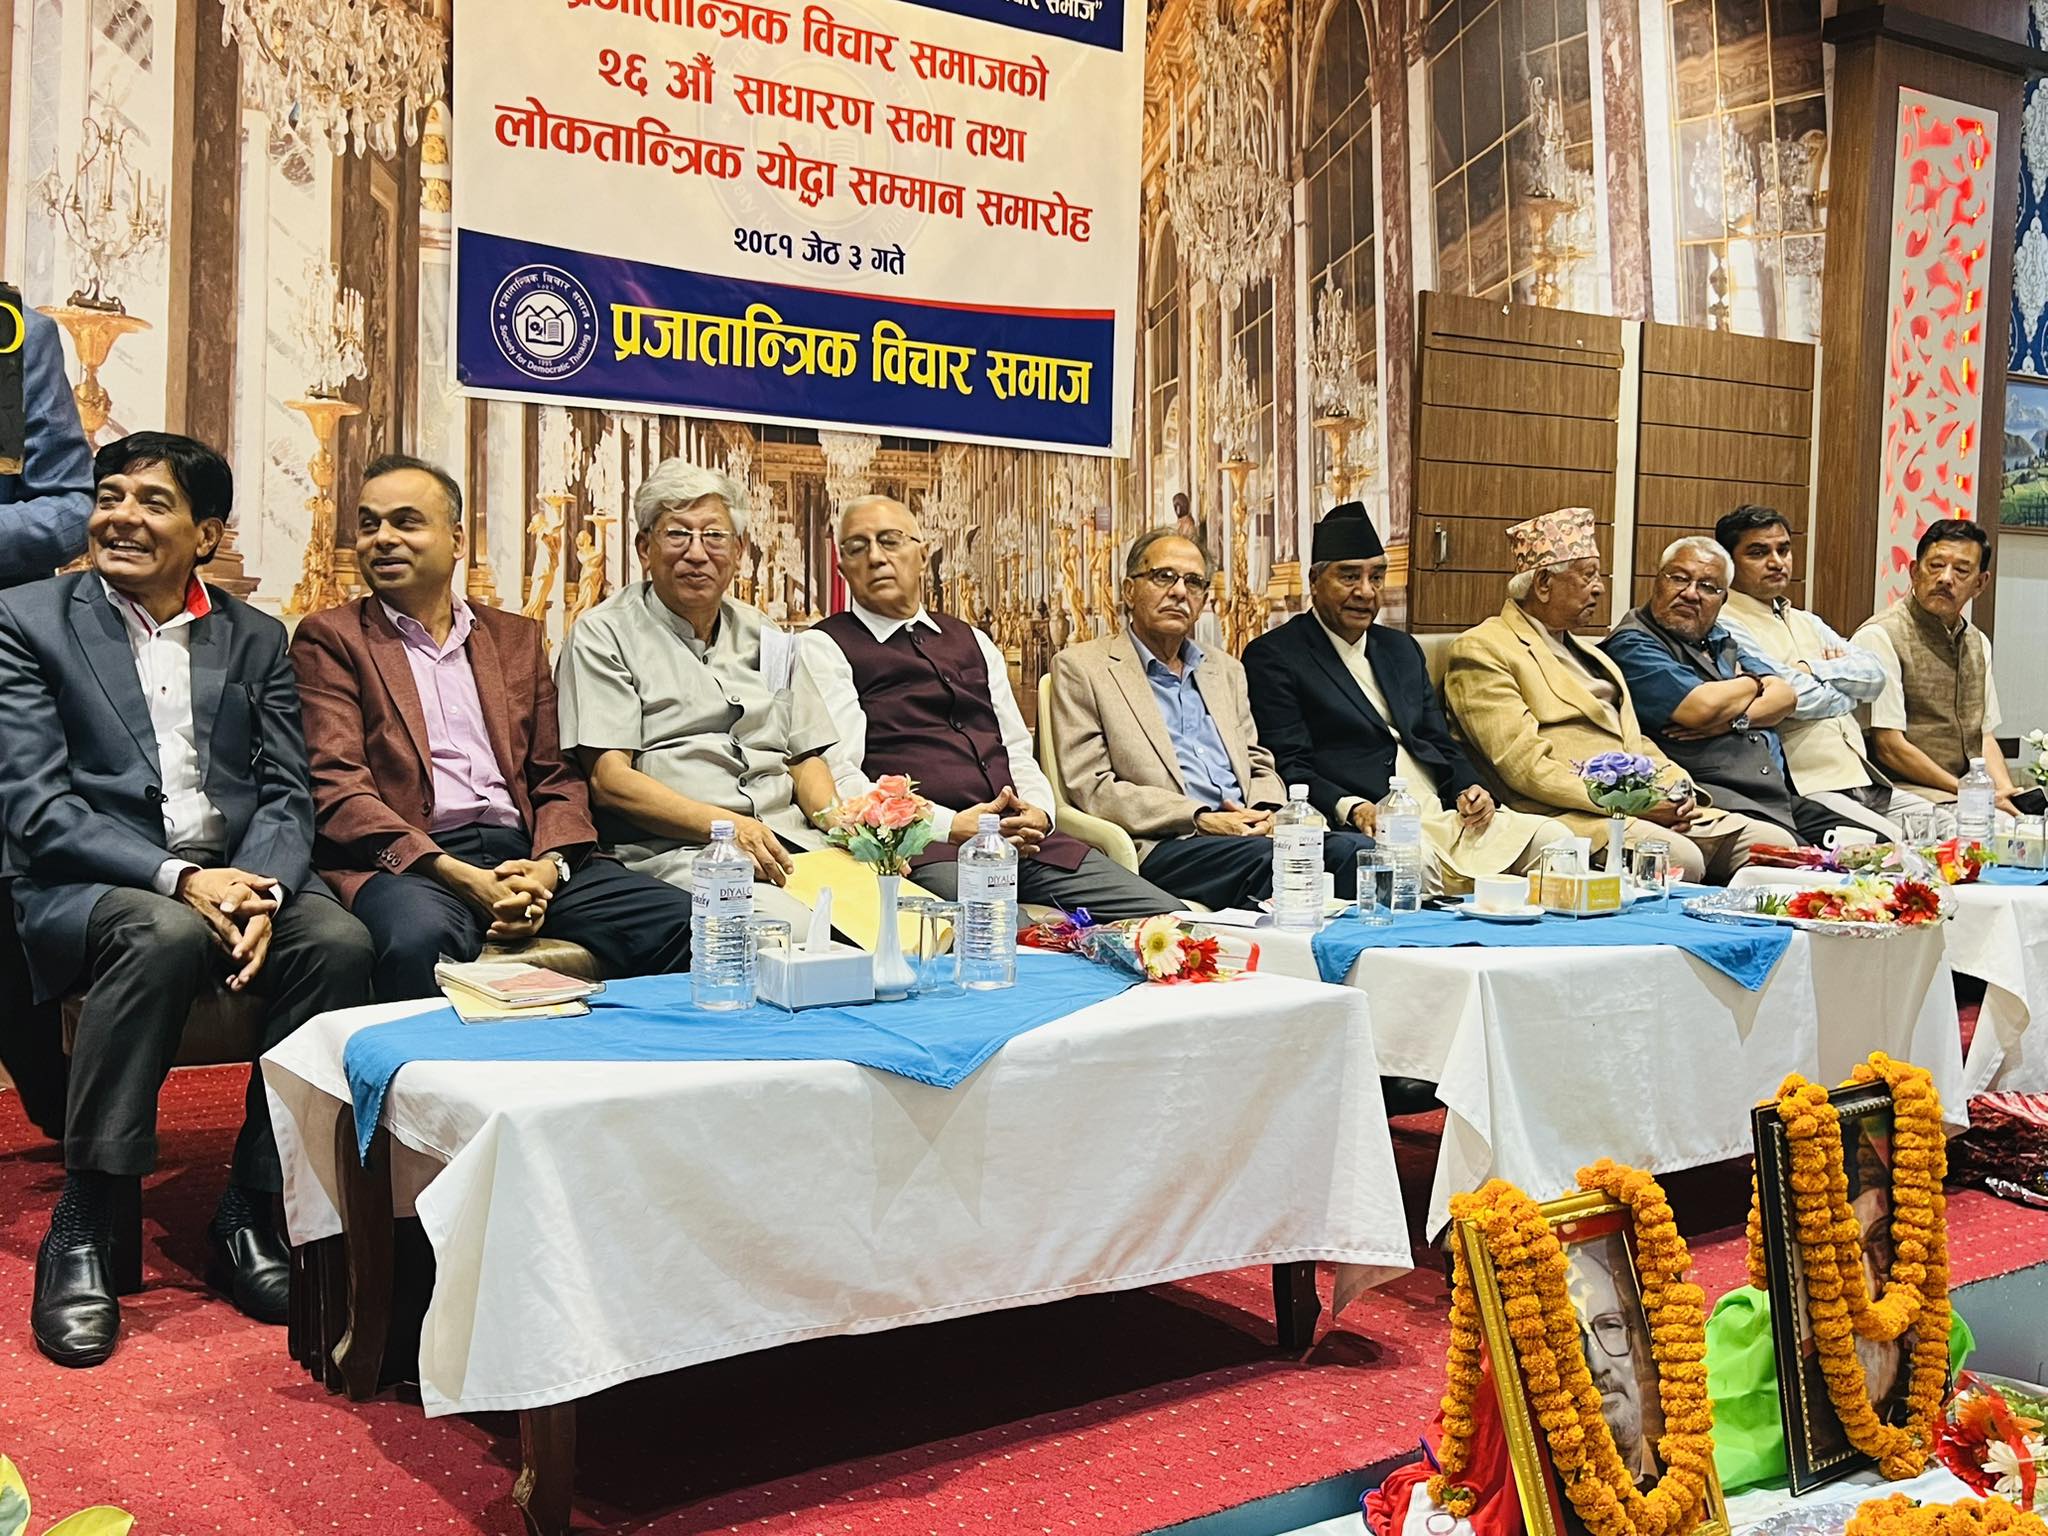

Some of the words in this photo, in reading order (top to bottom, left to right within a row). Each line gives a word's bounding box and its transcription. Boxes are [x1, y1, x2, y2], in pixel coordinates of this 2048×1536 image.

[803, 4, 898, 73] विचार
[910, 41, 1049, 102] समाजको
[599, 48, 649, 97] २६
[734, 73, 875, 135] साधारण
[886, 104, 955, 150] सभा
[966, 120, 1026, 163] तथा
[494, 96, 744, 180] लोकतान्त्रिक
[757, 142, 838, 208] योद्धा
[848, 166, 966, 219] सम्मान
[977, 190, 1092, 243] समारोह
[734, 227, 793, 259] २०८१
[801, 230, 842, 265] जेठ
[848, 245, 862, 271] ३
[871, 243, 906, 276] गते
[499, 324, 517, 356] Society
[516, 353, 528, 365] for
[527, 360, 571, 374] Democratic
[568, 334, 592, 366] Thinking
[610, 302, 860, 378] प्रजातान्त्रिक
[872, 319, 976, 396] विचार
[987, 349, 1092, 405] समाज
